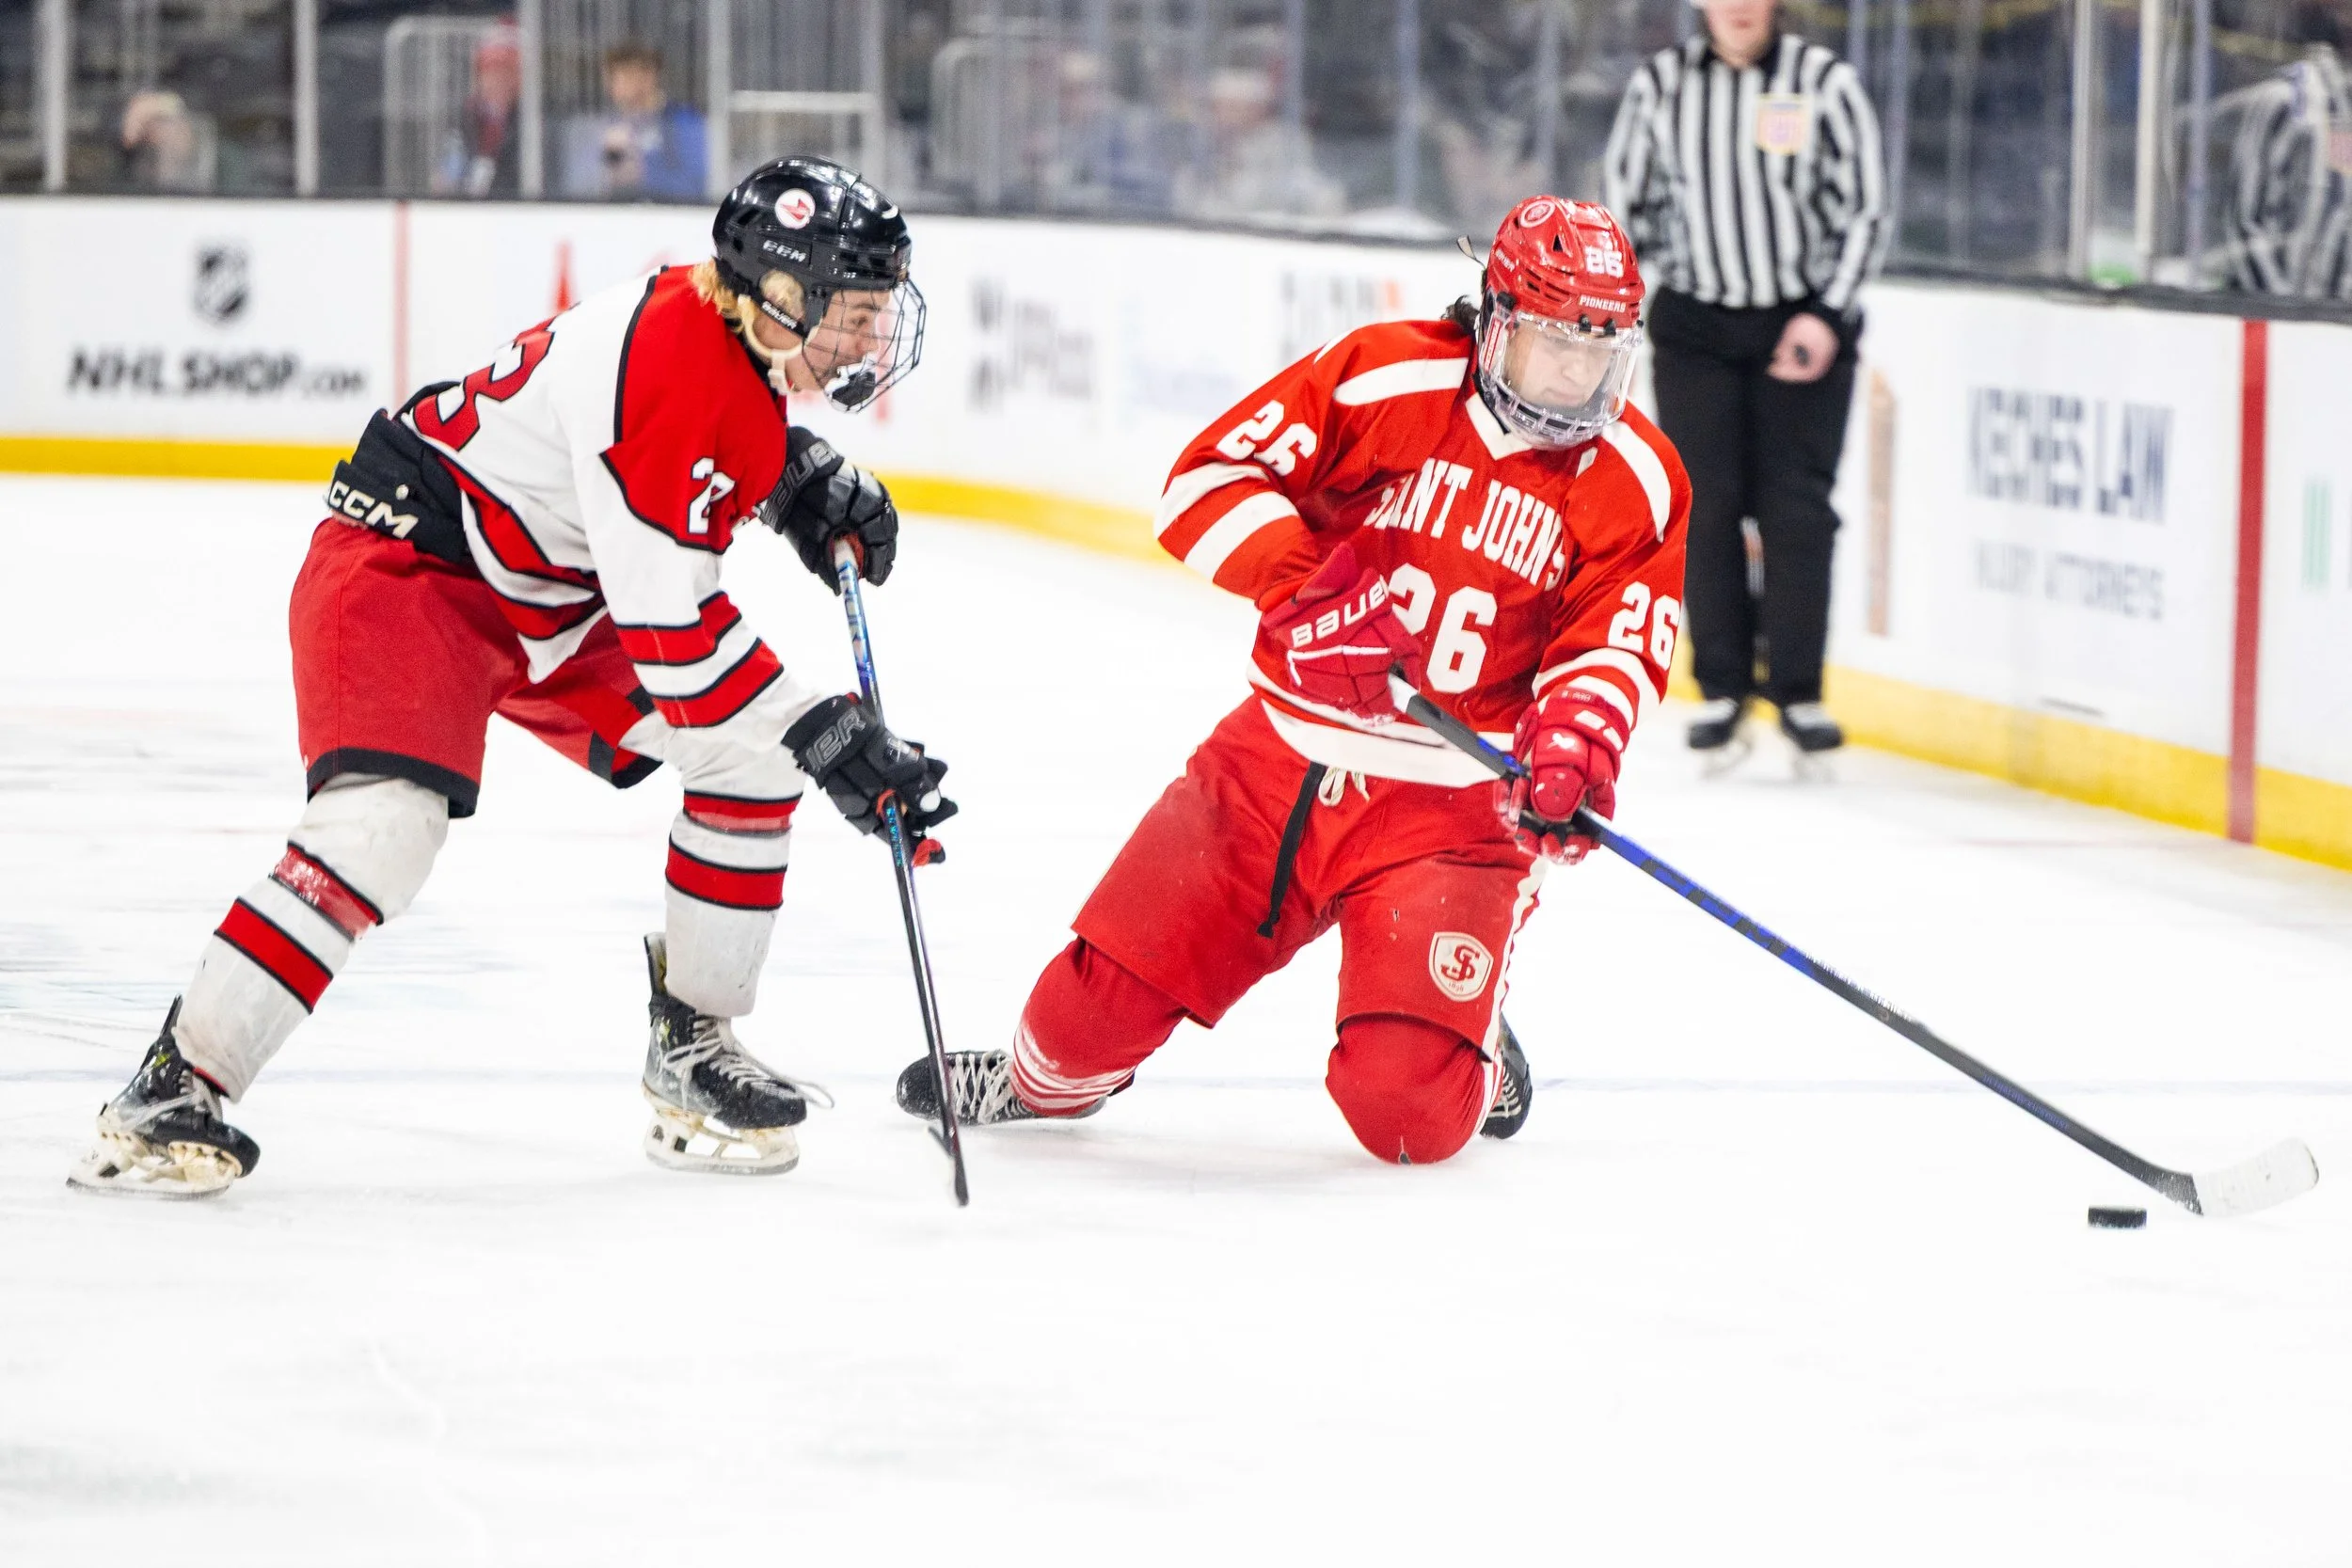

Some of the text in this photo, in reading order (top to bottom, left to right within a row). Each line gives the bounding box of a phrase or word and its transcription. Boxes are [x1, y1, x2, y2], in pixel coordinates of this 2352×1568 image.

[1585, 245, 1624, 278] 26
[1580, 294, 1627, 313] PIONEERS
[1216, 399, 1317, 477] 26
[329, 480, 419, 540] CCM
[1389, 562, 1498, 694] 26
[1608, 580, 1679, 671] 26
